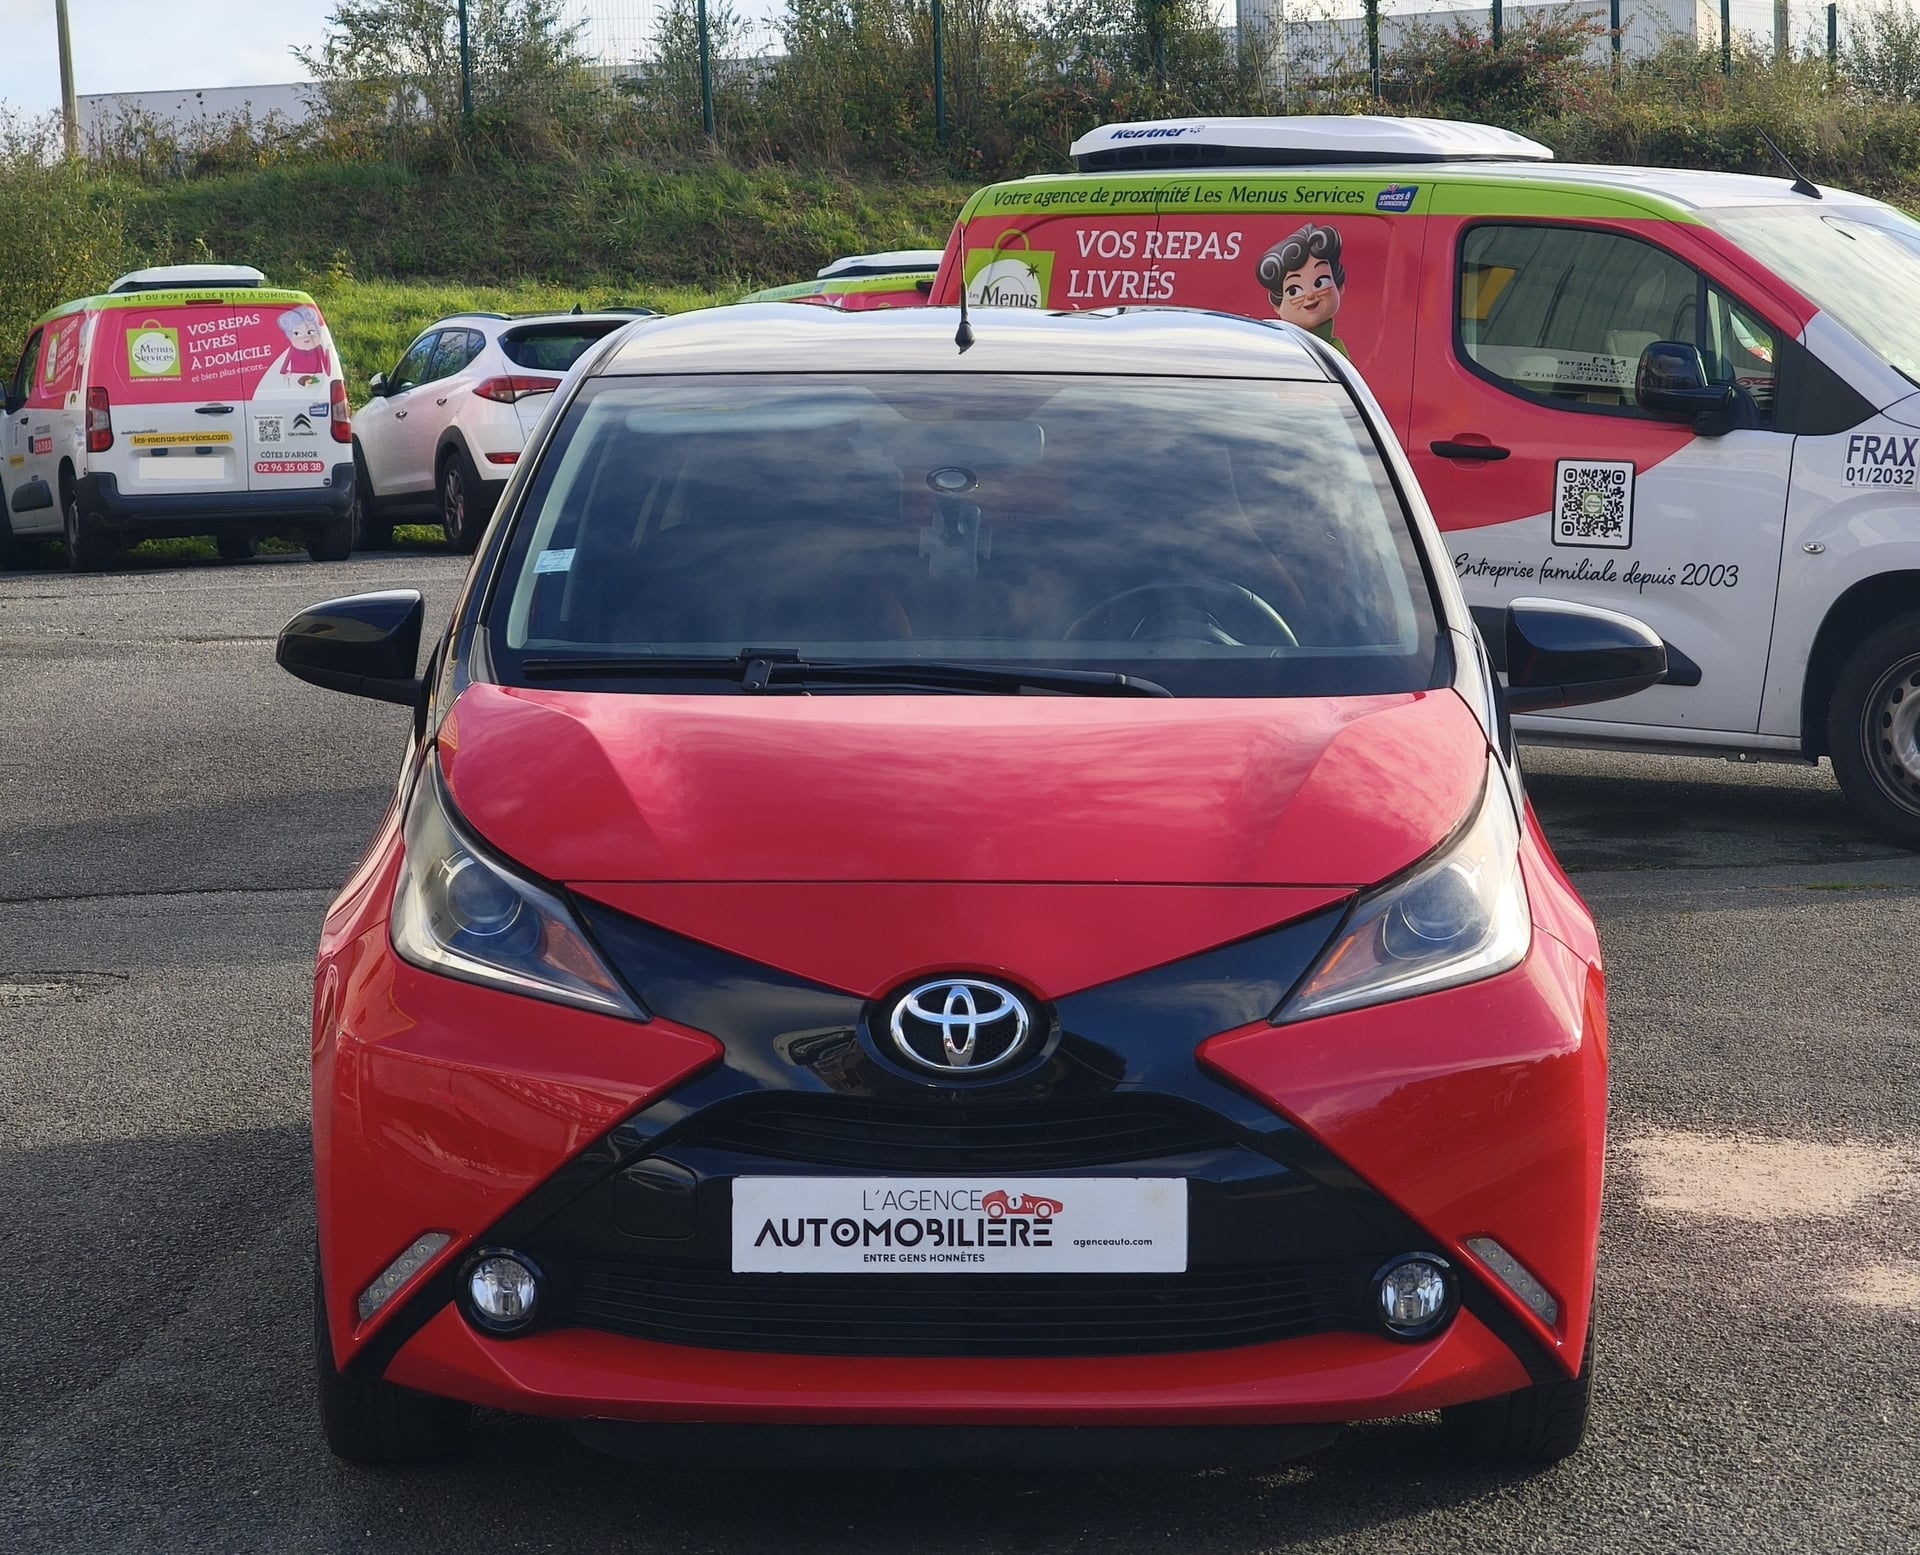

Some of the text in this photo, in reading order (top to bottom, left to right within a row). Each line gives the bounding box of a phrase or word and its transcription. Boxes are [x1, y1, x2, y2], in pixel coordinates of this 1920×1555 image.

[1110, 127, 1188, 140] Kerstner
[993, 192, 1033, 207] Votre
[1033, 190, 1088, 207] agence
[1090, 187, 1109, 202] de
[1110, 185, 1191, 207] proximité
[1194, 186, 1223, 203] Les
[1228, 186, 1289, 204] Menus
[1293, 186, 1366, 204] Services
[1076, 230, 1243, 260] VOS REPAS
[1067, 264, 1176, 299] LIVRÉS
[980, 285, 1038, 308] Menus
[187, 313, 261, 336] VOS REPAS
[140, 344, 174, 354] Menus
[188, 333, 237, 354] LIVRÉS
[134, 353, 174, 362] Services
[191, 345, 272, 371] À DOMICILE
[191, 375, 200, 383] et
[201, 371, 219, 382] bien
[219, 369, 236, 381] plus
[133, 433, 229, 444] les-menus-services.com
[285, 450, 318, 458] D'ARMOR
[1846, 435, 1919, 467] FRAX
[257, 462, 321, 472] 02 96 35 08 38
[1846, 467, 1914, 484] 01/2032
[1454, 553, 1739, 594] Entreprise familiale depuis 2003
[863, 1190, 1018, 1211] L'AGENCE 1
[1073, 1238, 1153, 1248] agenceauto.com
[863, 1250, 985, 1262] ENTRE GENS HONNÊTES
